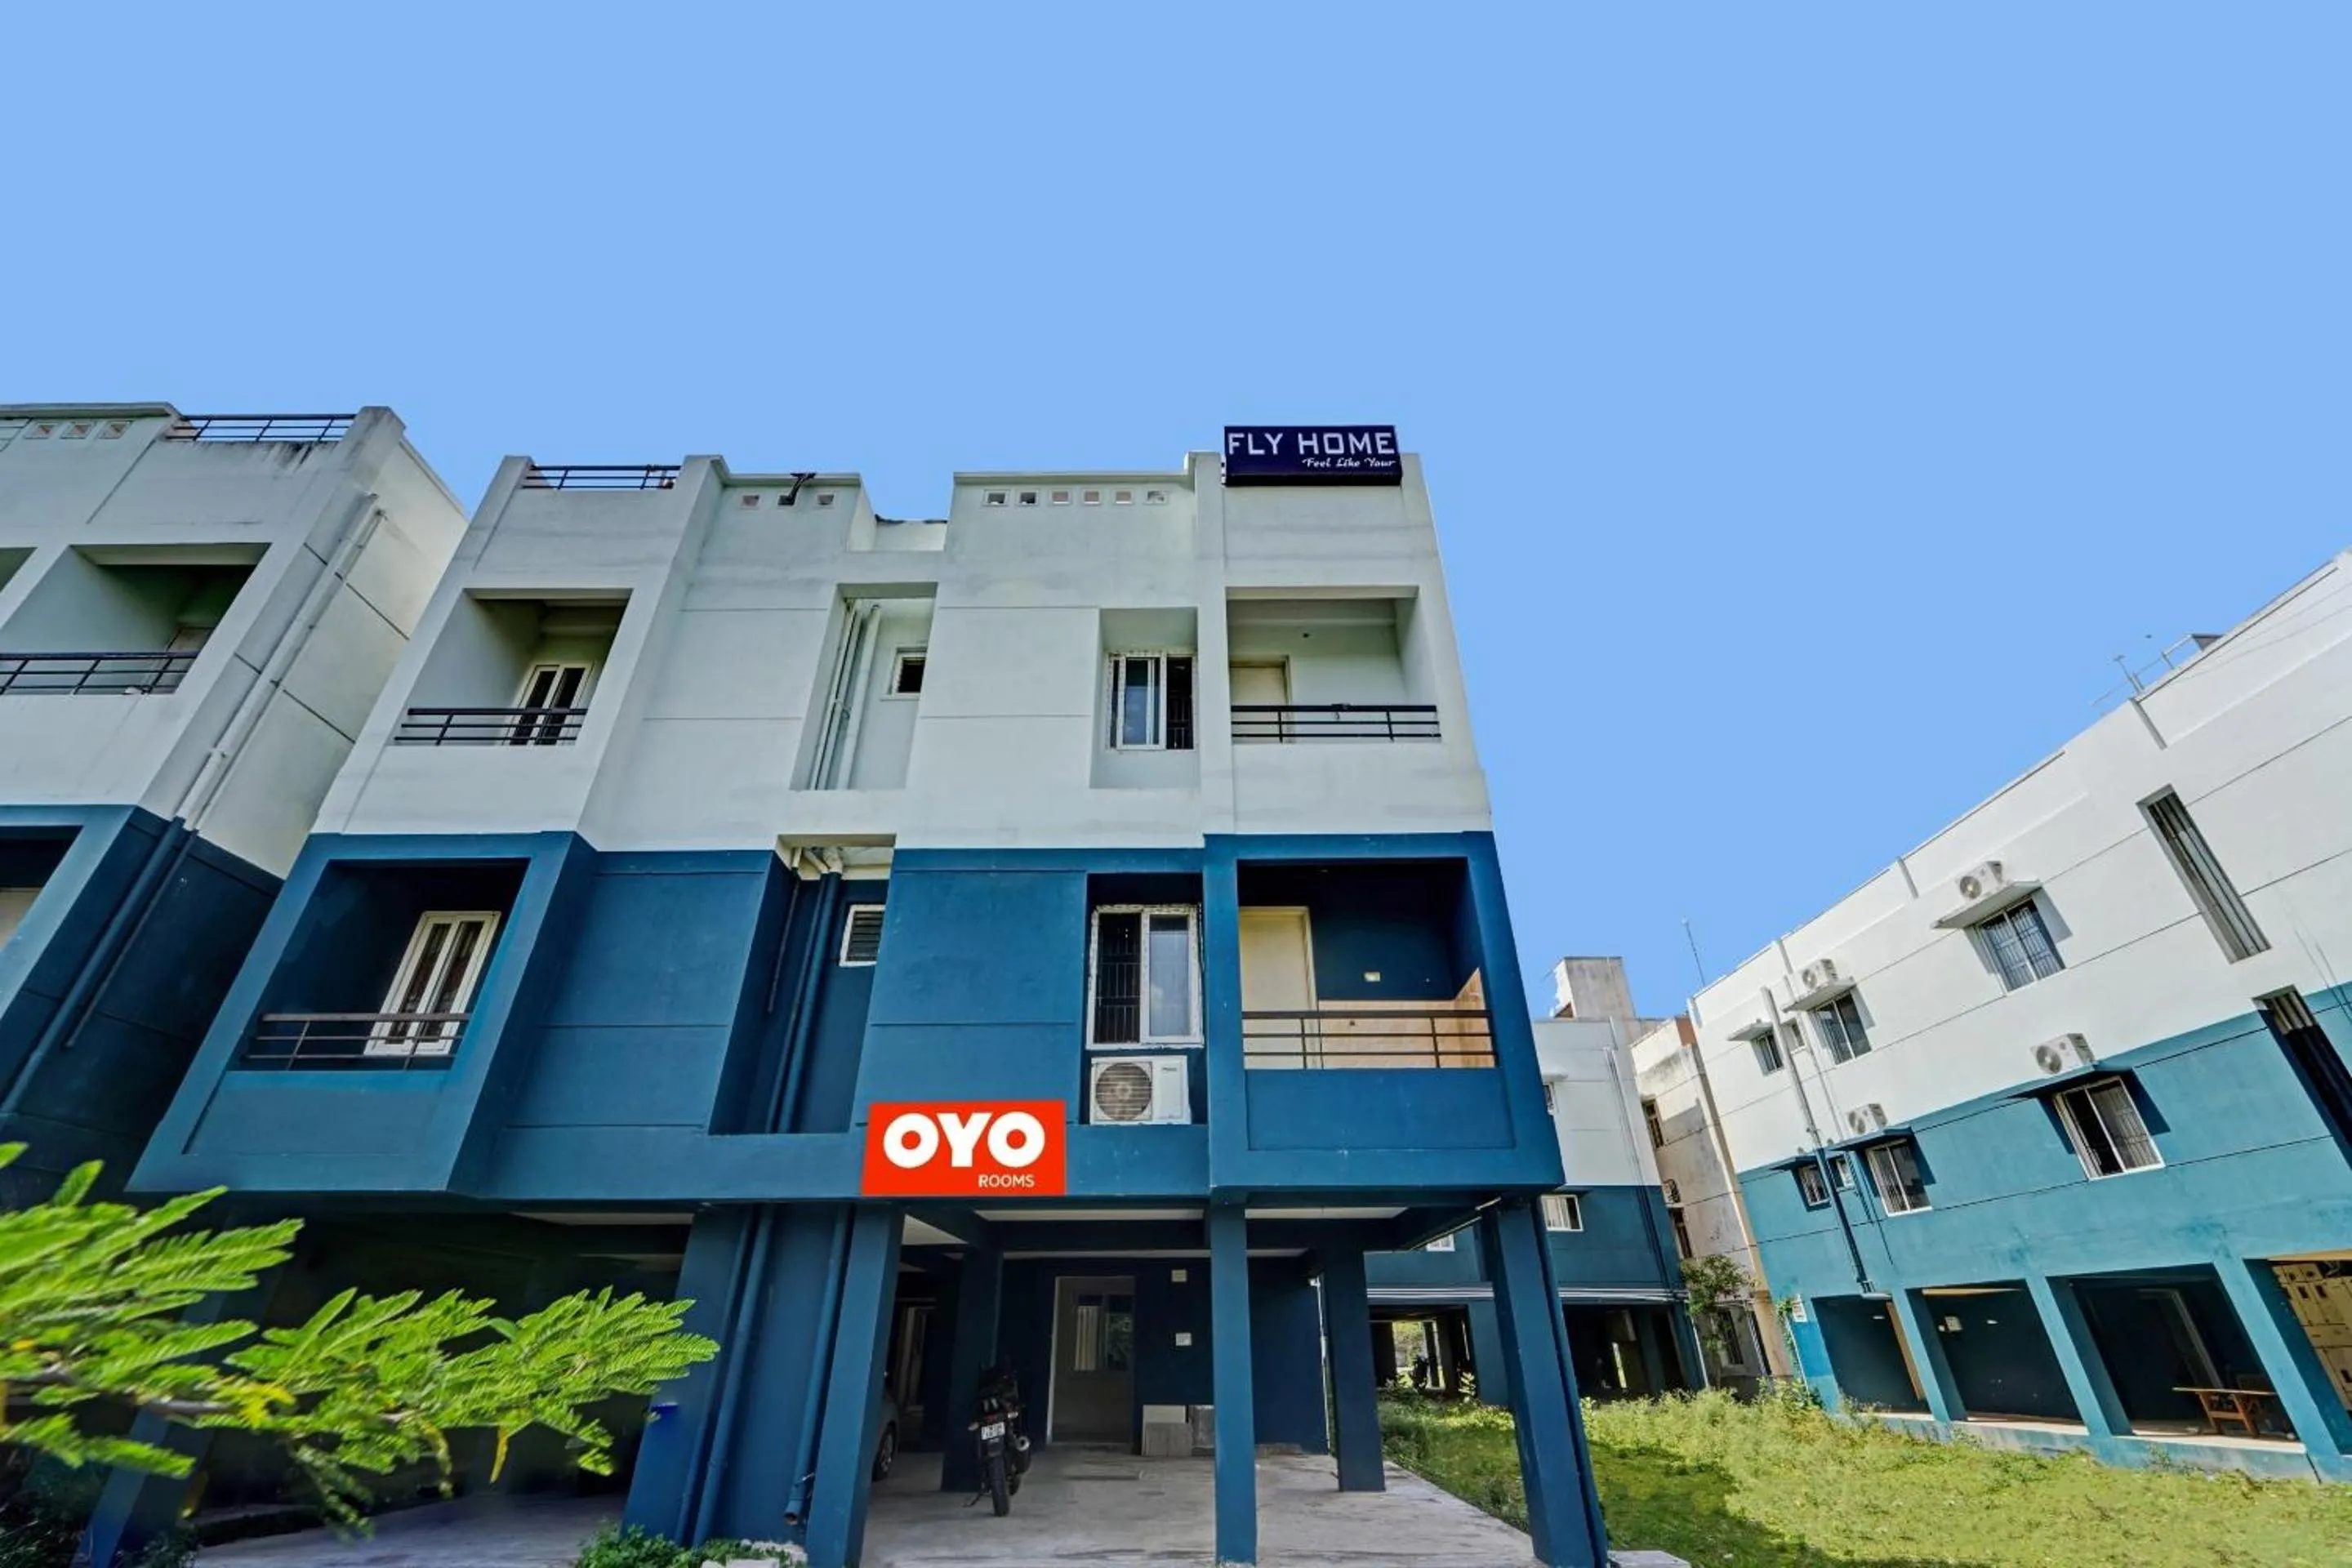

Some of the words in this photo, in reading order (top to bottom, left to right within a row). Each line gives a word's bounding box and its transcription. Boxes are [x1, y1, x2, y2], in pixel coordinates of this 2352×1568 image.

[1227, 432, 1283, 455] FLY
[1298, 432, 1395, 455] HOME
[1302, 457, 1331, 468] Feel
[1335, 457, 1361, 468] Like
[883, 1111, 1045, 1169] OYO
[978, 1174, 1035, 1188] ROOMS
